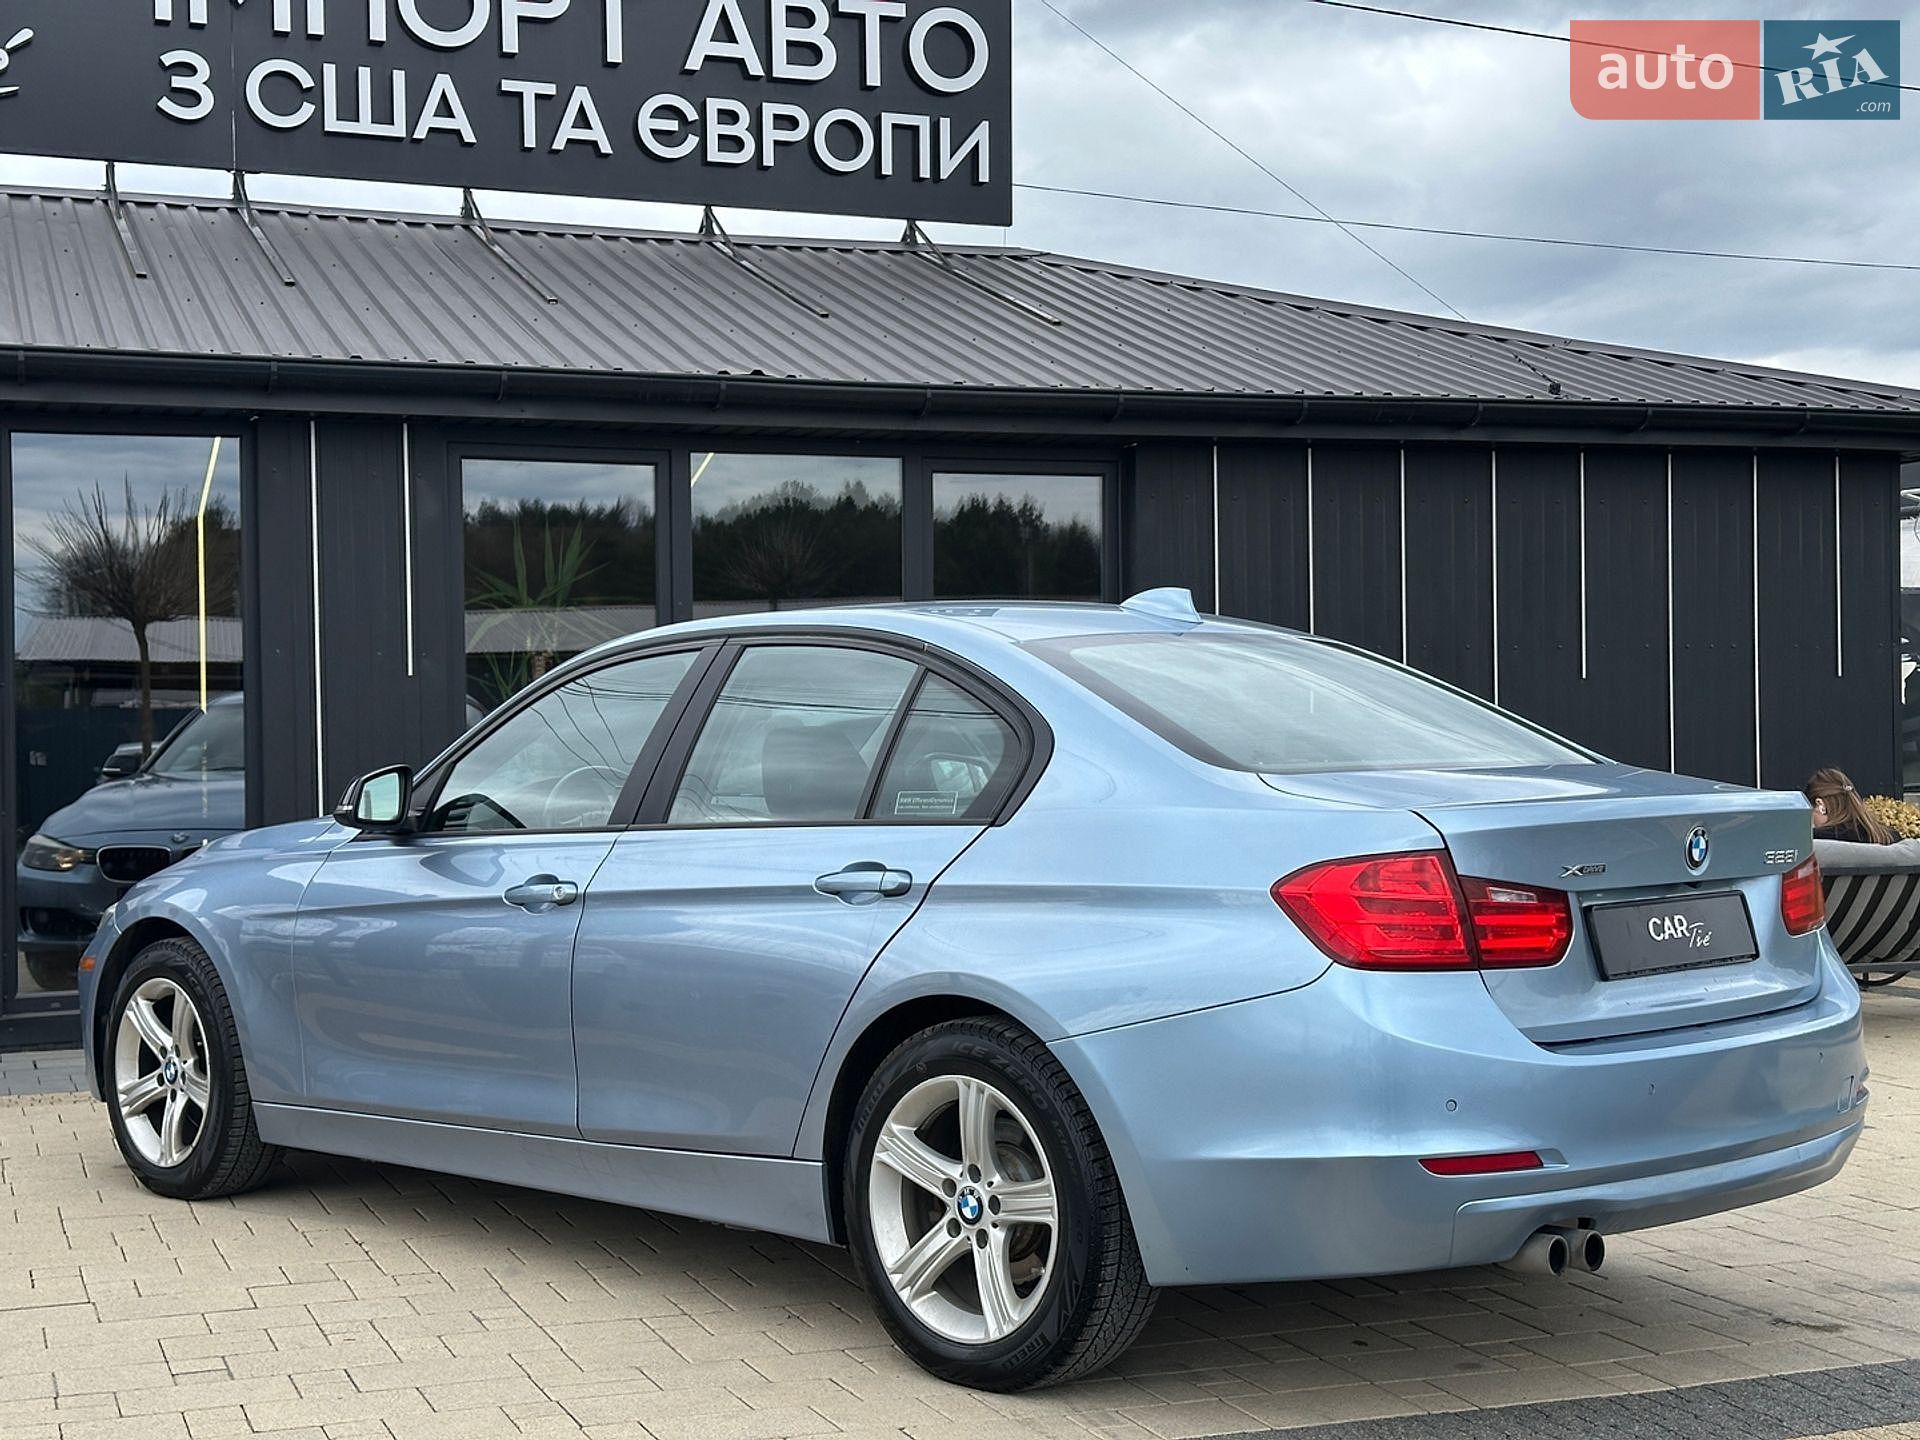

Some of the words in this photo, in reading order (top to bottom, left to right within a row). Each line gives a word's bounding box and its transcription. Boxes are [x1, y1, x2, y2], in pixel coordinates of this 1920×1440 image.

[684, 0, 989, 93] АВТО
[157, 49, 215, 120] З
[245, 58, 477, 144] США
[500, 79, 613, 155] ТА
[637, 93, 990, 183] ЄВРОПИ
[1648, 914, 1690, 941] CAR
